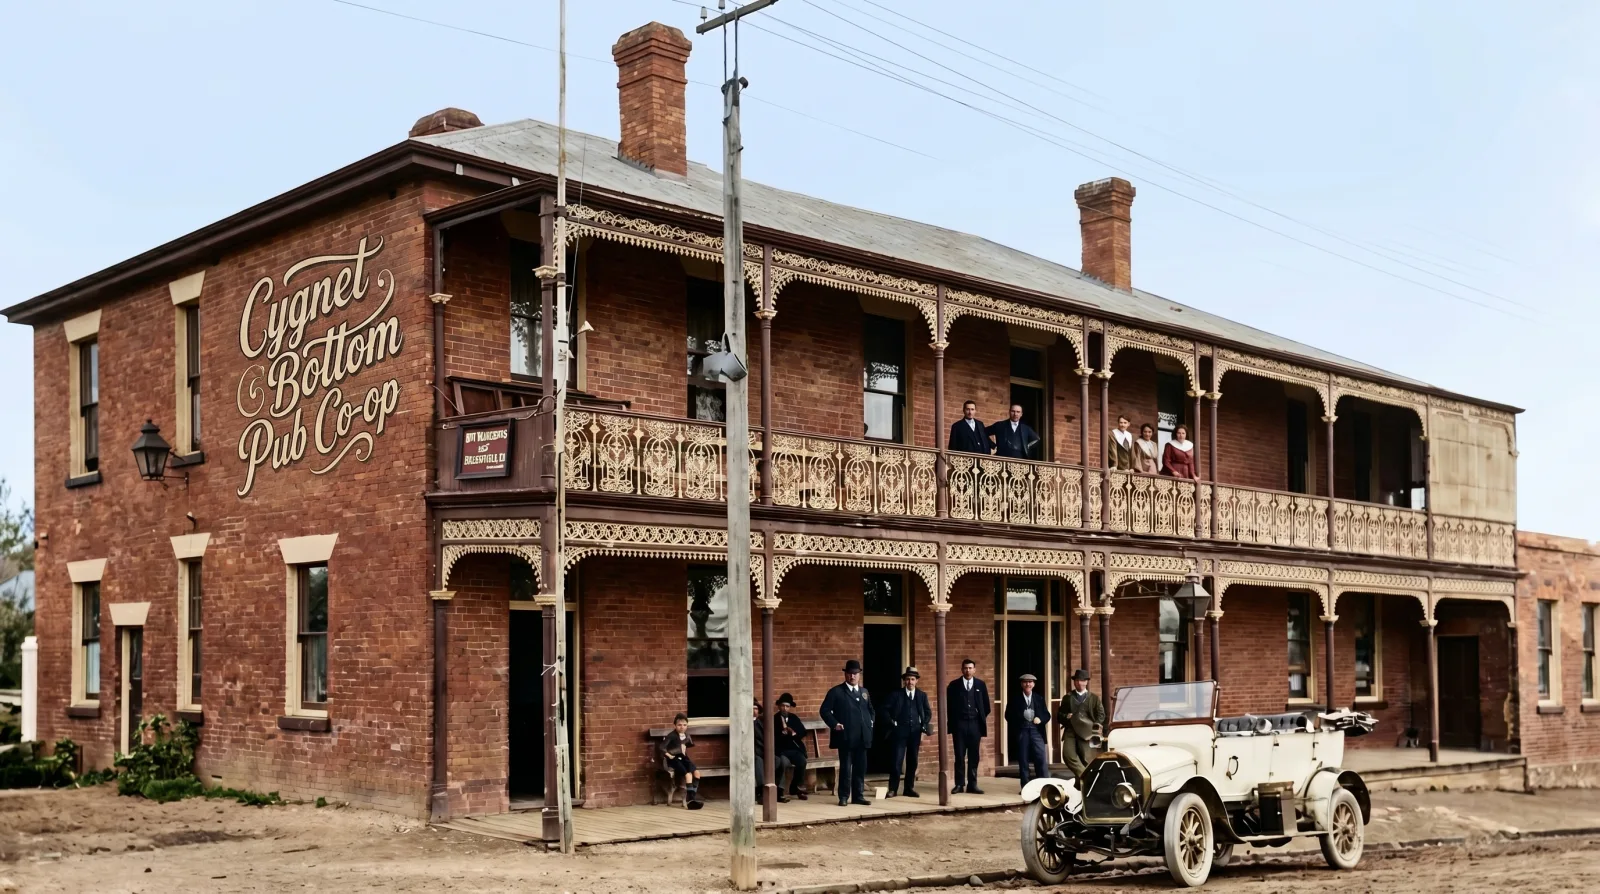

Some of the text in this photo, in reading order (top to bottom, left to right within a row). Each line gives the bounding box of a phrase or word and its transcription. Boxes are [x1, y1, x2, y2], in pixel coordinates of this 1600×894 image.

[239, 235, 384, 359] Cygnet
[267, 268, 403, 418] Bottom
[237, 378, 402, 496] Pub Co-op
